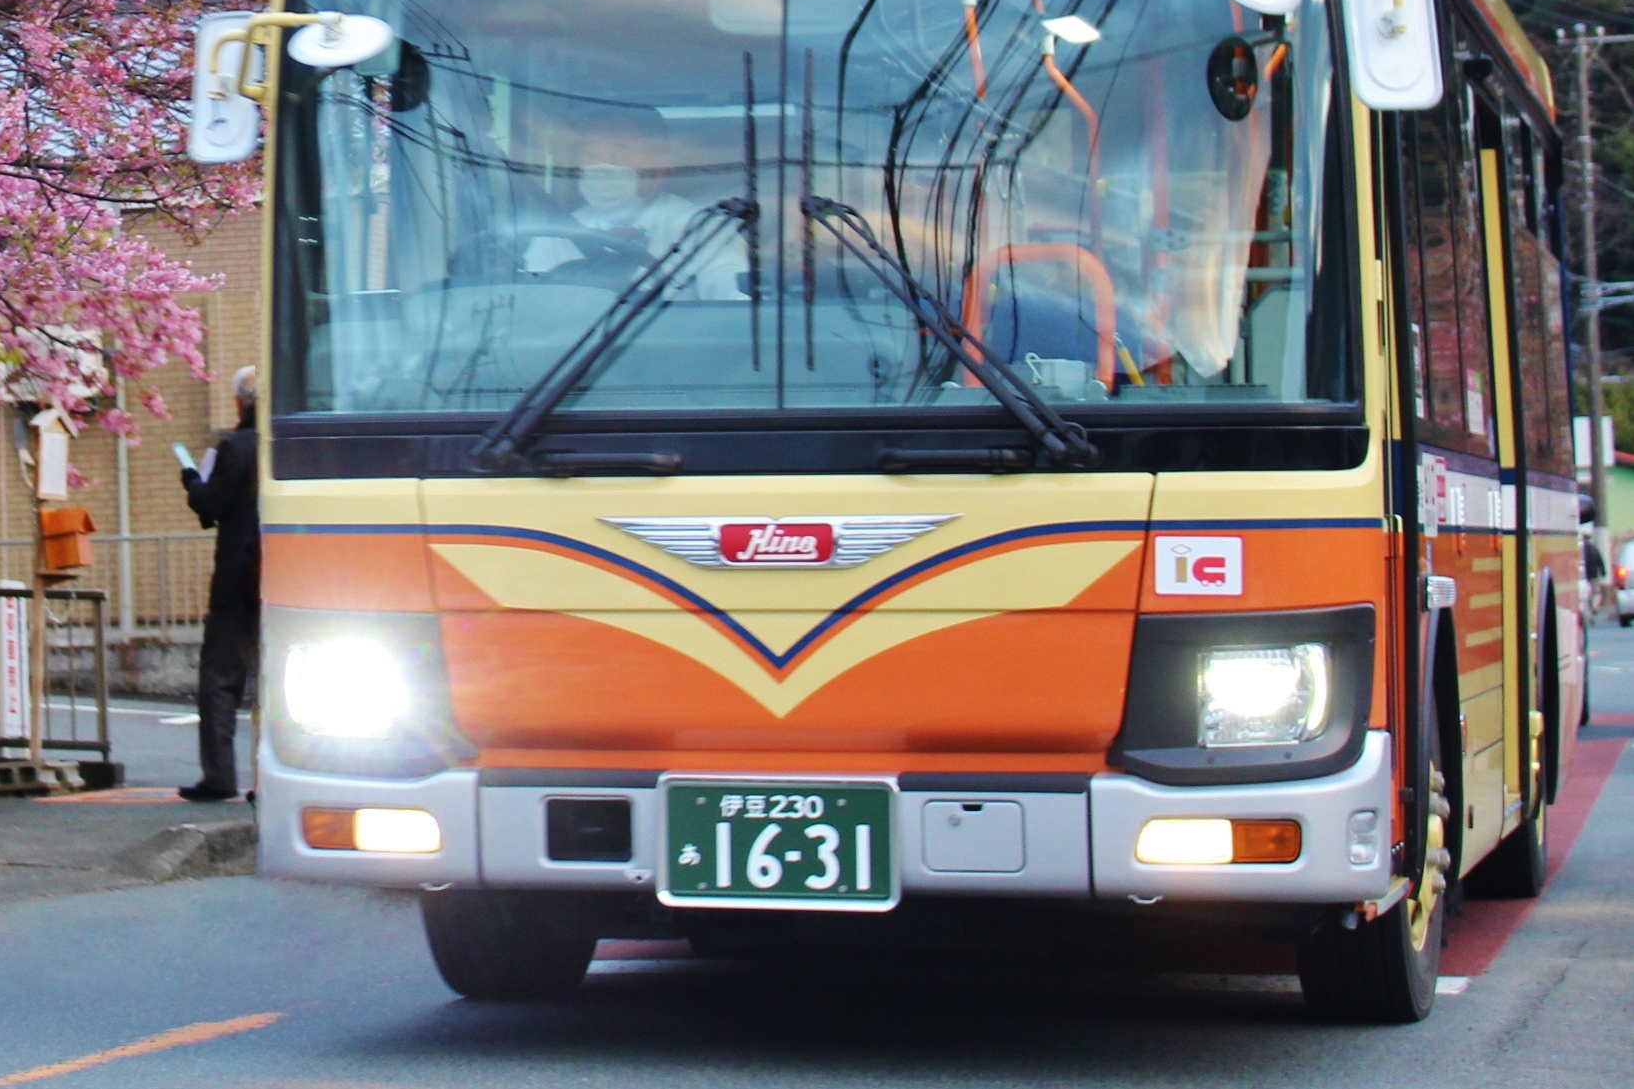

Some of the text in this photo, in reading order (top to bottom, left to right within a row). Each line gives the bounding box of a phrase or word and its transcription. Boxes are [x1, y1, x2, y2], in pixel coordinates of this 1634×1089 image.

[736, 523, 819, 560] Hino
[678, 821, 871, 890] あ 16-31
